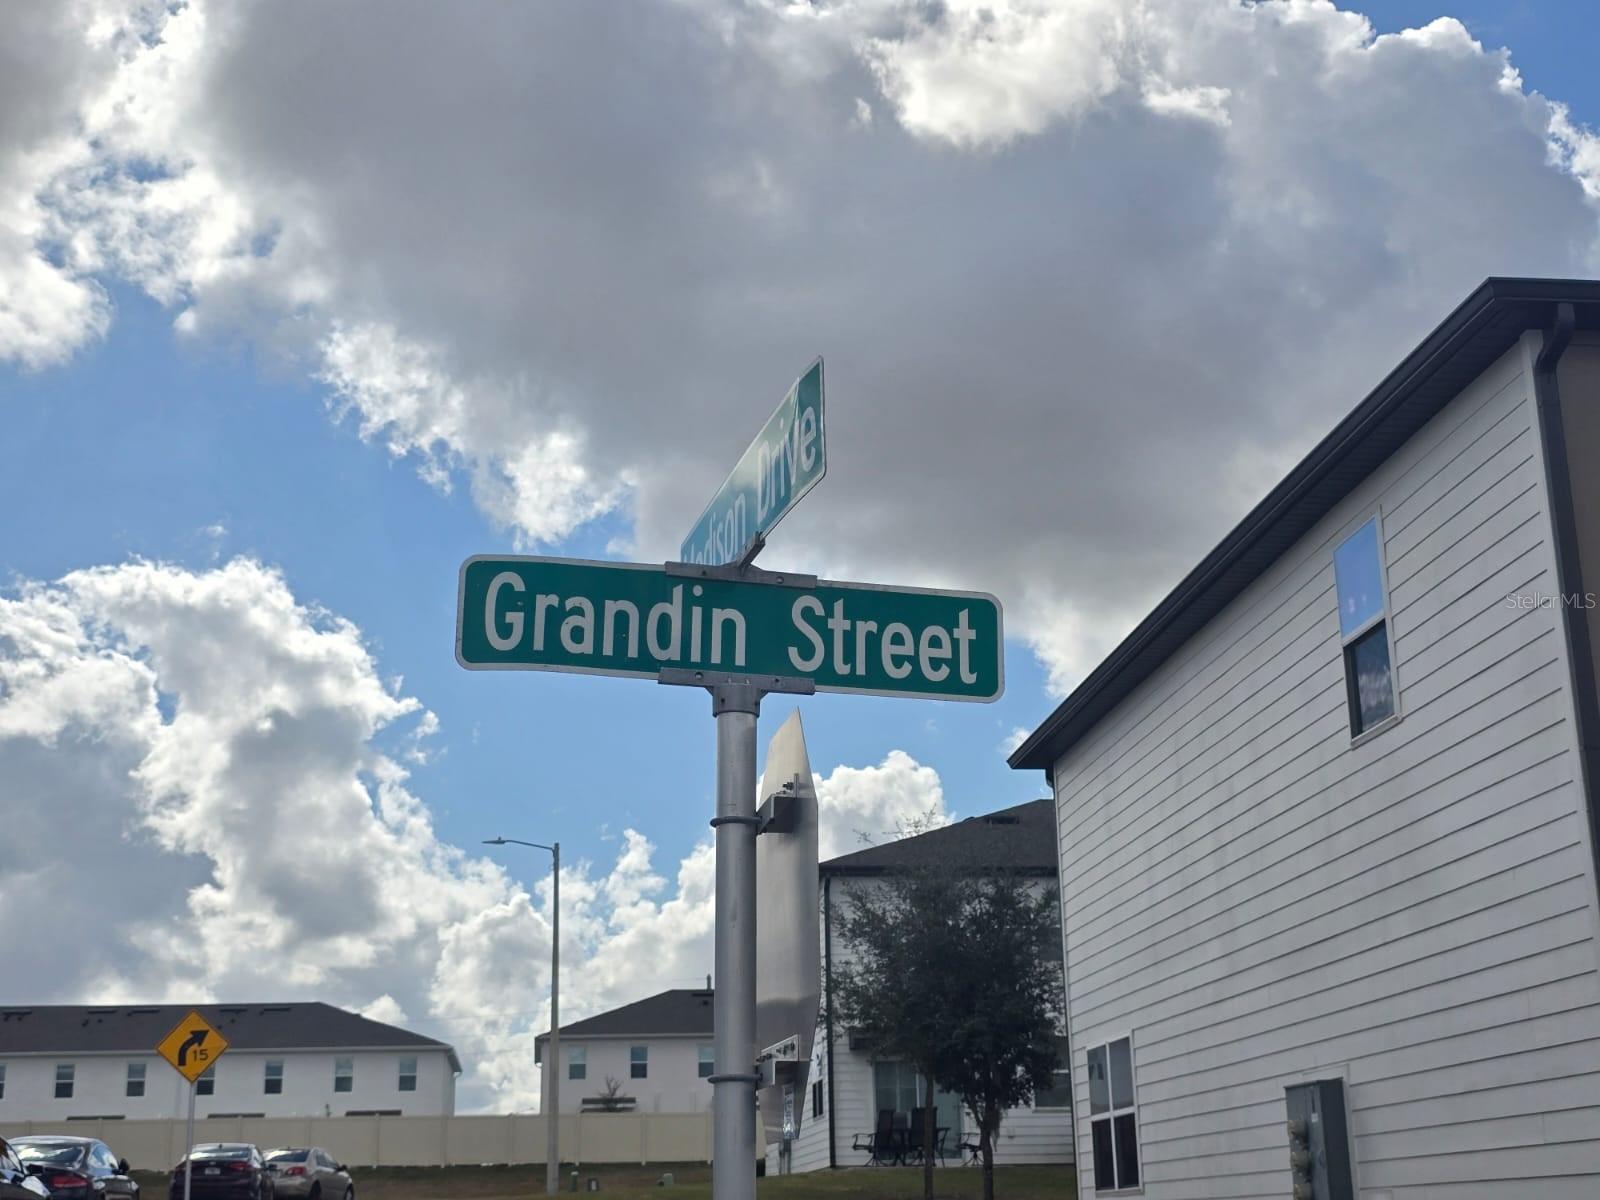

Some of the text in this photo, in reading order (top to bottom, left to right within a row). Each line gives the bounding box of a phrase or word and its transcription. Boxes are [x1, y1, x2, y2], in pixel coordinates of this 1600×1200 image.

[757, 406, 817, 526] Drive
[484, 571, 978, 685] Grandin Street
[192, 1048, 209, 1062] 15
